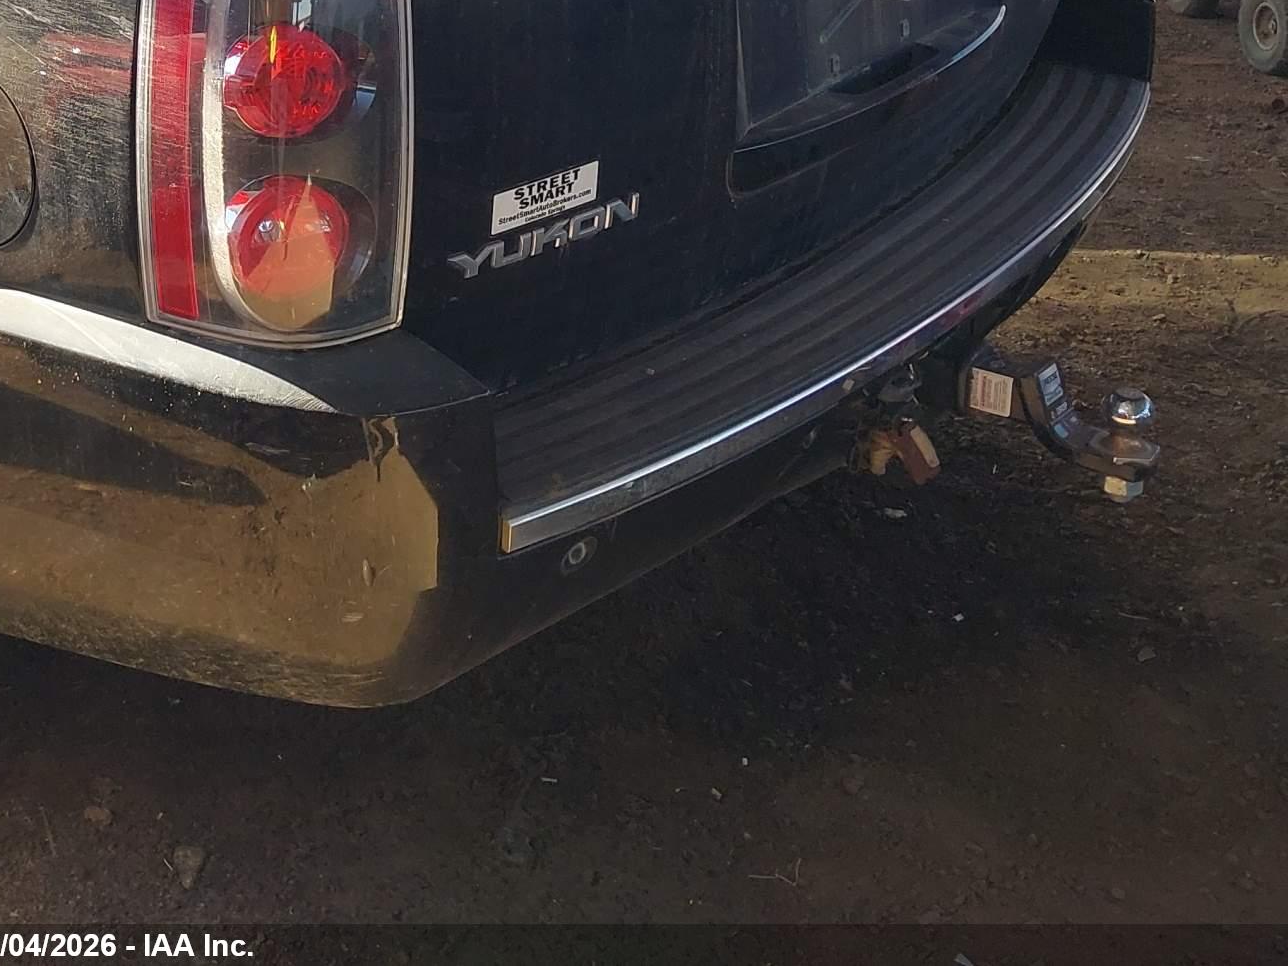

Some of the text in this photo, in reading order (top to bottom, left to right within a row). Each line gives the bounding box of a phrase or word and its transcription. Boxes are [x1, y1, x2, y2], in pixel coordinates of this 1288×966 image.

[514, 168, 581, 200] STREET
[519, 182, 575, 210] SMART
[498, 188, 592, 226] StreetSmartAutoBrokers.com
[447, 192, 640, 279] YUKON
